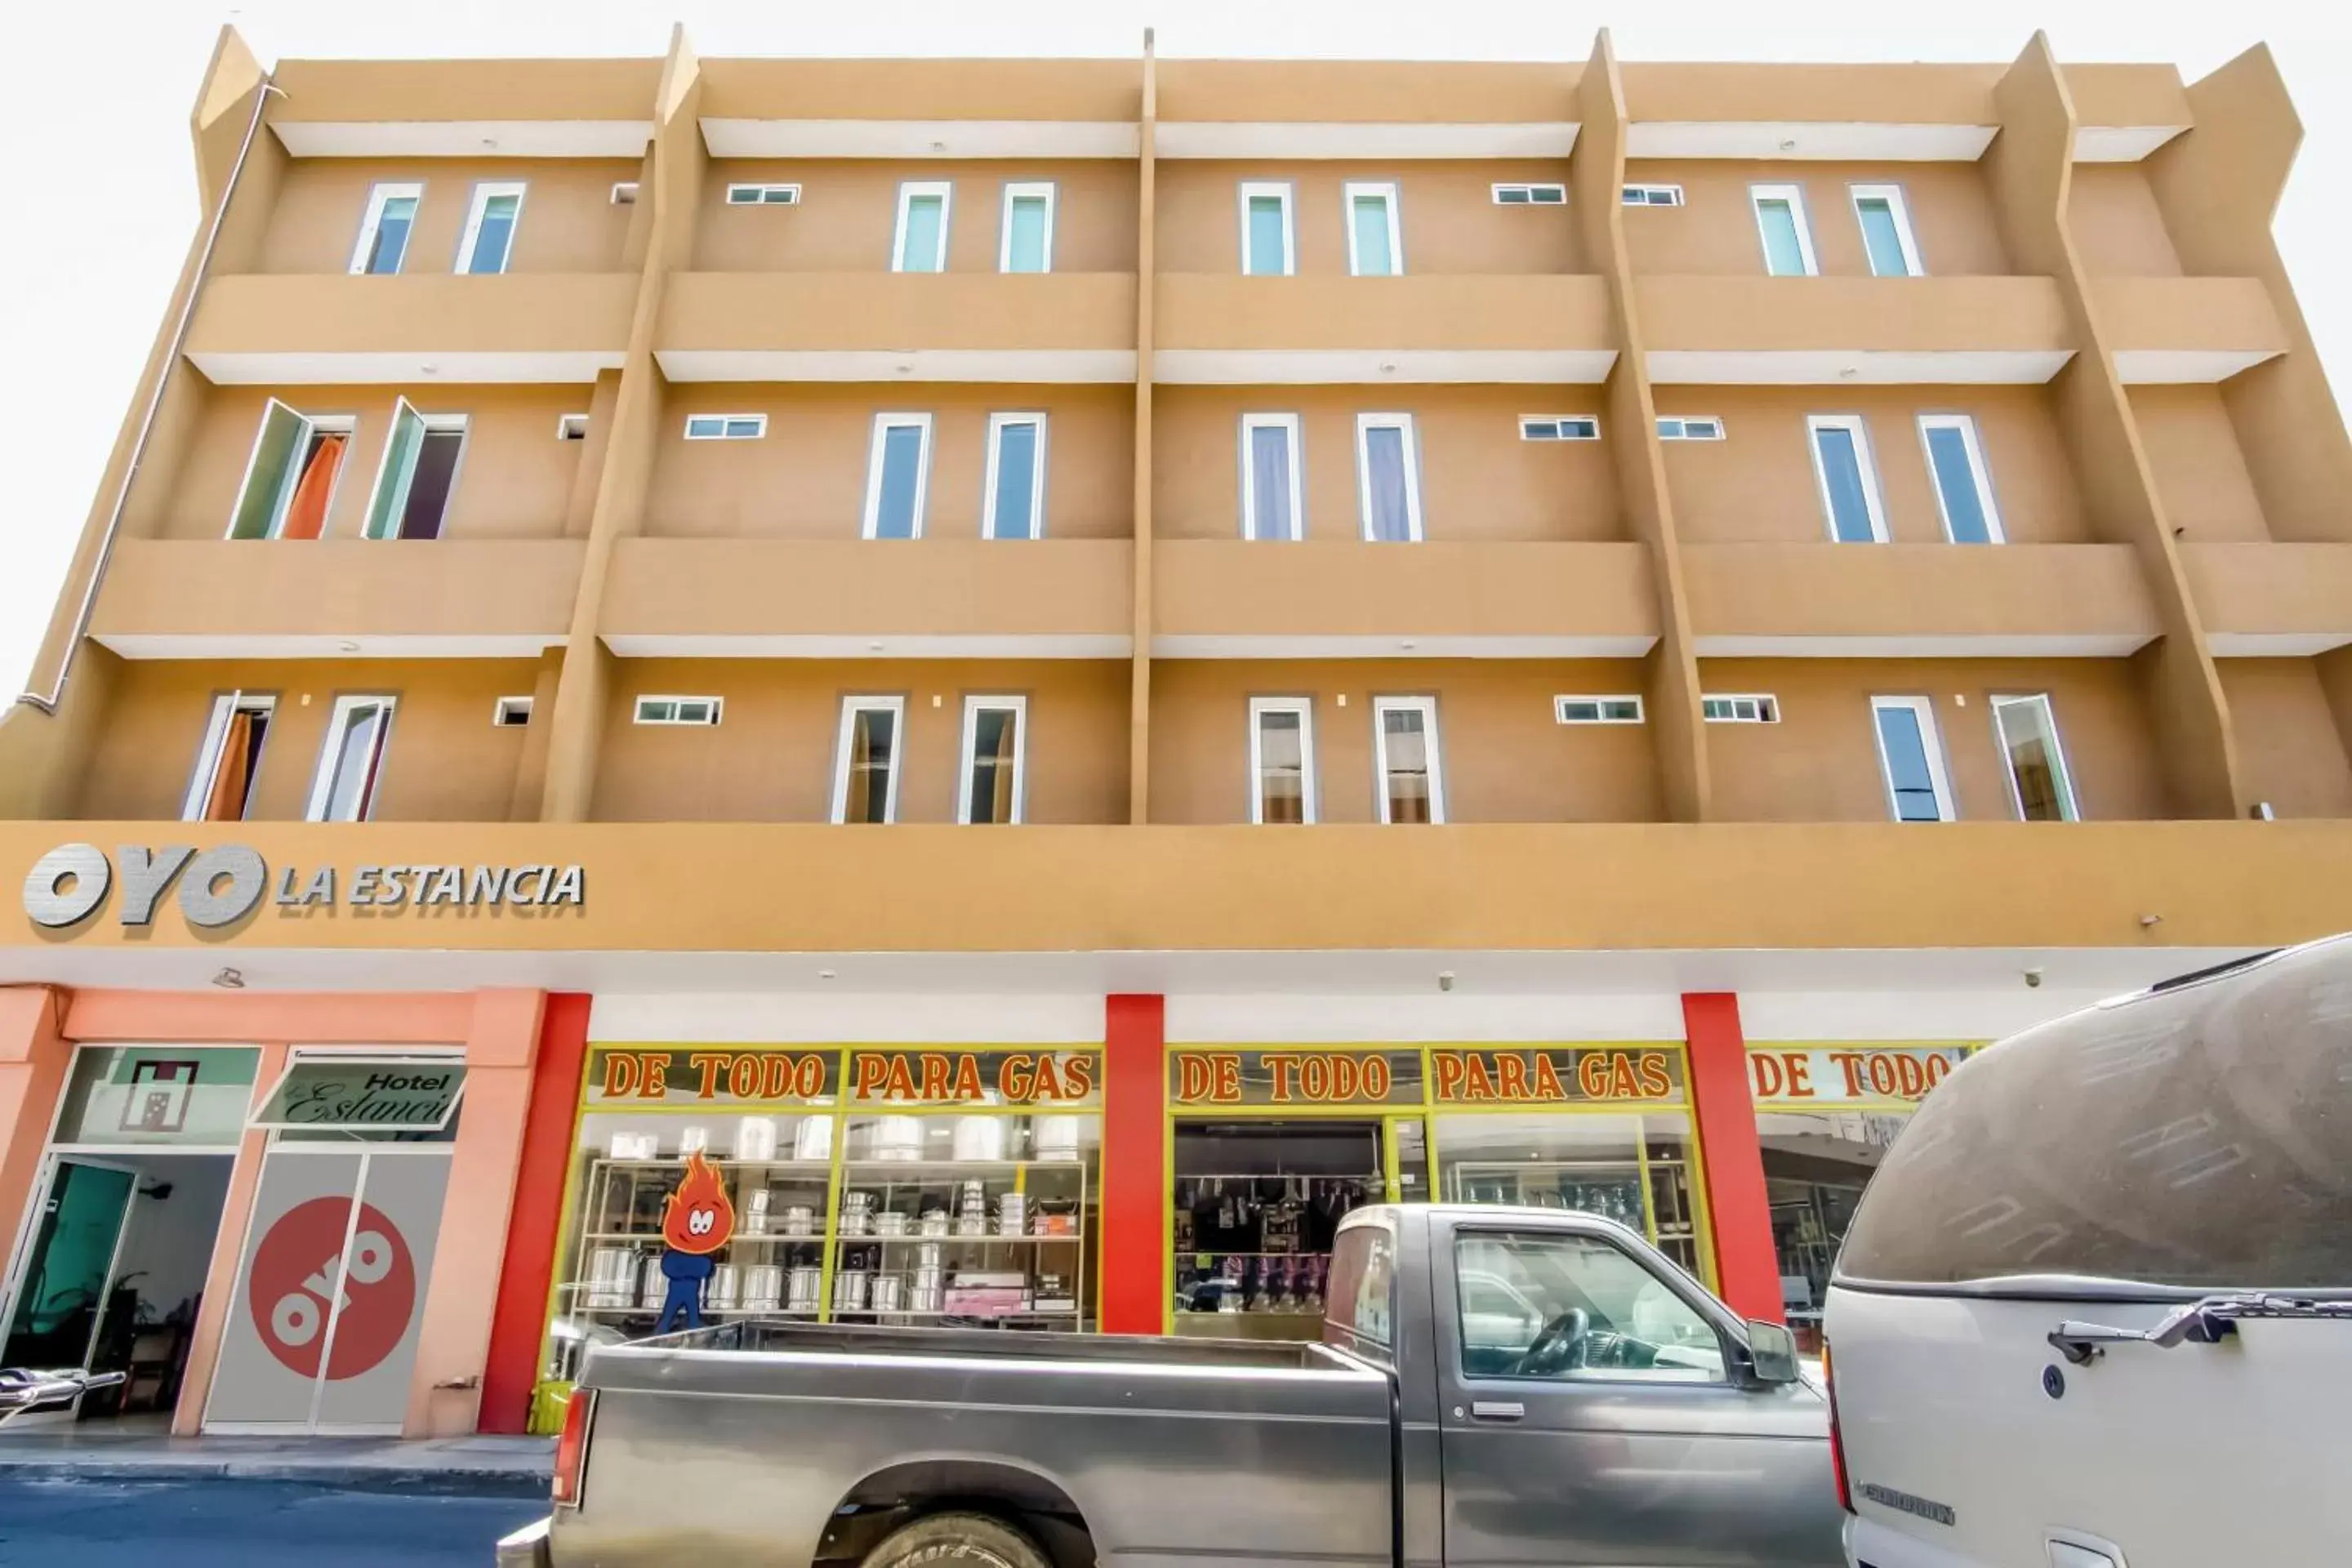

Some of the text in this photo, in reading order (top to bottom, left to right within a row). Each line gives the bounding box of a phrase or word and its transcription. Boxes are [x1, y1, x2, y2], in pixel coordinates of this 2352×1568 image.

[23, 843, 585, 929] OYO LA ESTANCIA
[364, 1073, 451, 1091] Hotel
[603, 1053, 1093, 1100] DE TODO PARA GAS
[1178, 1053, 1673, 1102] DE TODO PARA GAS
[1749, 1052, 1952, 1097] DE TODO
[285, 1081, 450, 1123] Estanci
[271, 1230, 393, 1347] OYO
